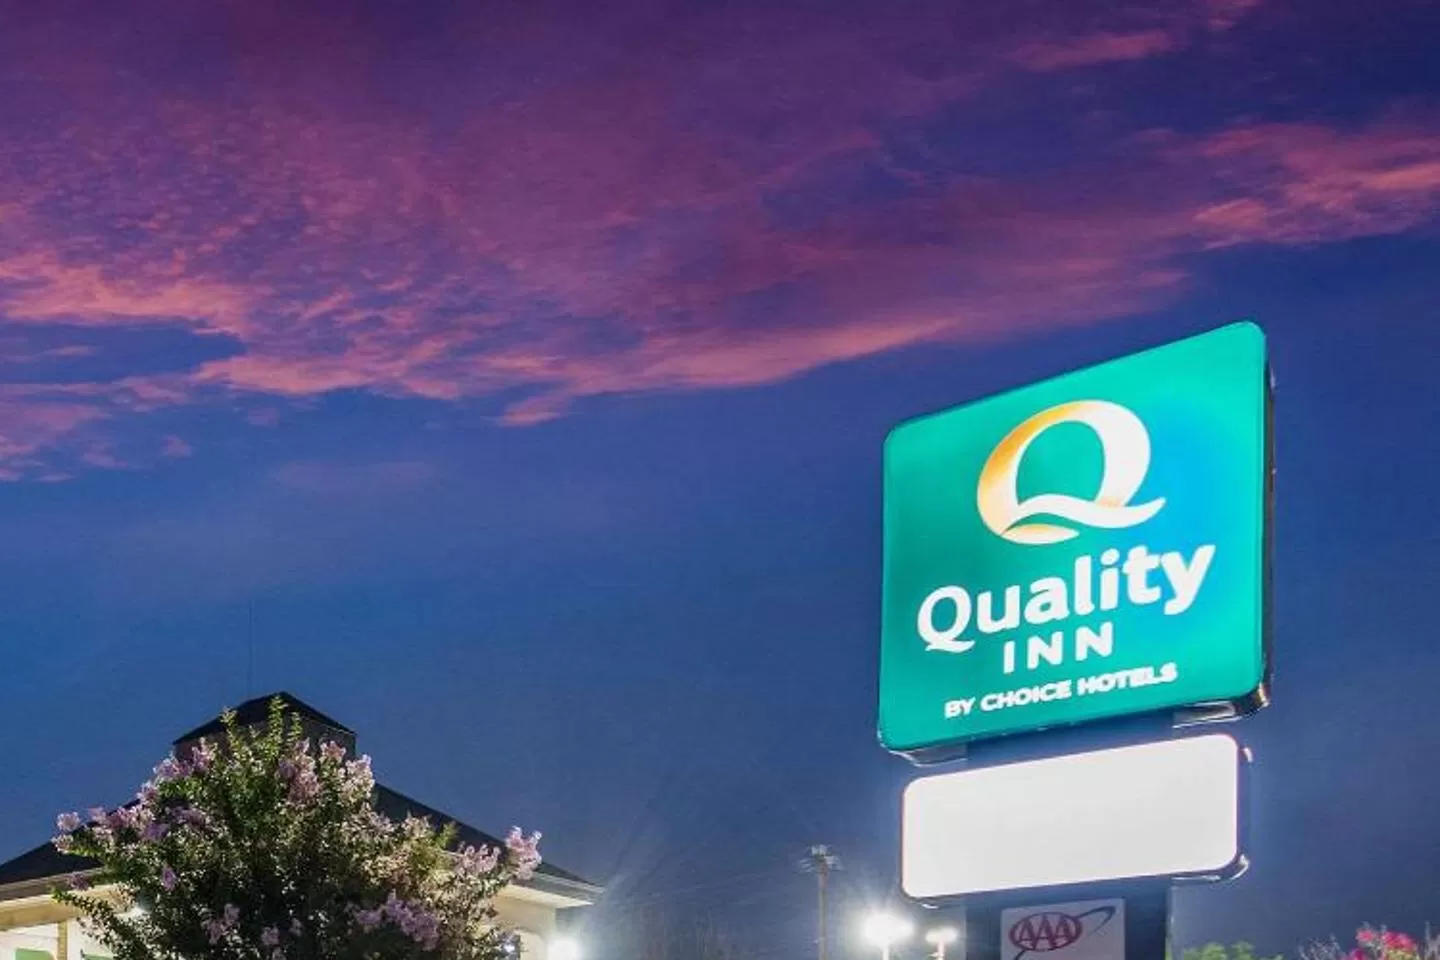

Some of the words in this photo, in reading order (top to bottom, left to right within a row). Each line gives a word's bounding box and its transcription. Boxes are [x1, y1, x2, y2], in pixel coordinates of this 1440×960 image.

[976, 399, 1167, 545] Q
[917, 544, 1216, 654] Quality
[1003, 621, 1114, 674] INN
[944, 697, 976, 719] BY
[980, 680, 1072, 712] CHOICE
[1076, 662, 1178, 696] HOTELS
[1017, 914, 1074, 950] AAA
